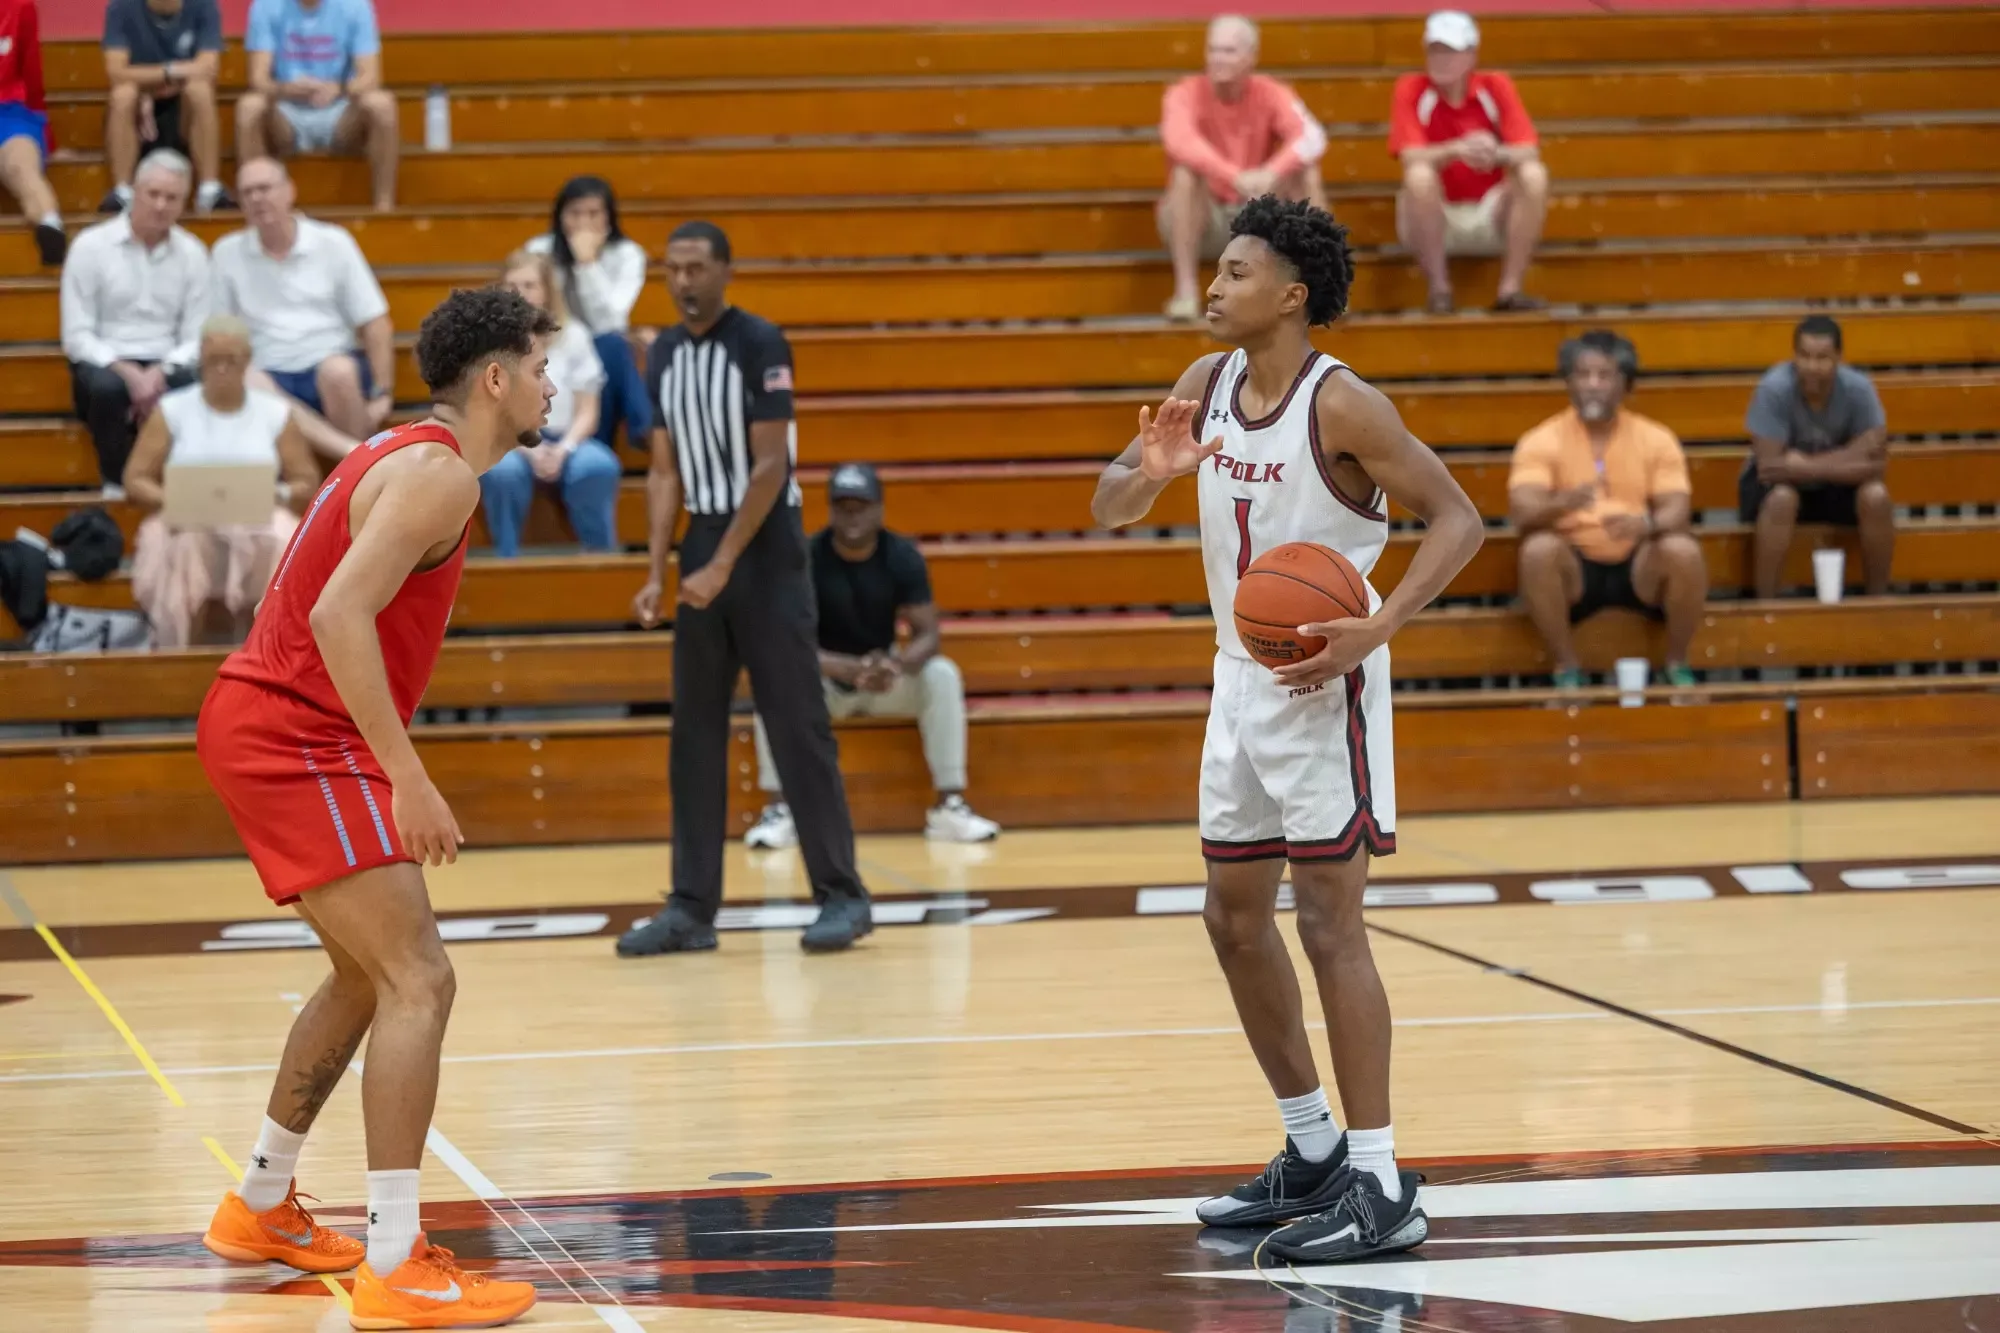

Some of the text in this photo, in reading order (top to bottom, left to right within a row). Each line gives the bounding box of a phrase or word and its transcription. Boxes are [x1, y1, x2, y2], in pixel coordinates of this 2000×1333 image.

[1214, 454, 1286, 483] POLK
[1231, 496, 1253, 580] 1
[1287, 682, 1325, 699] POLK
